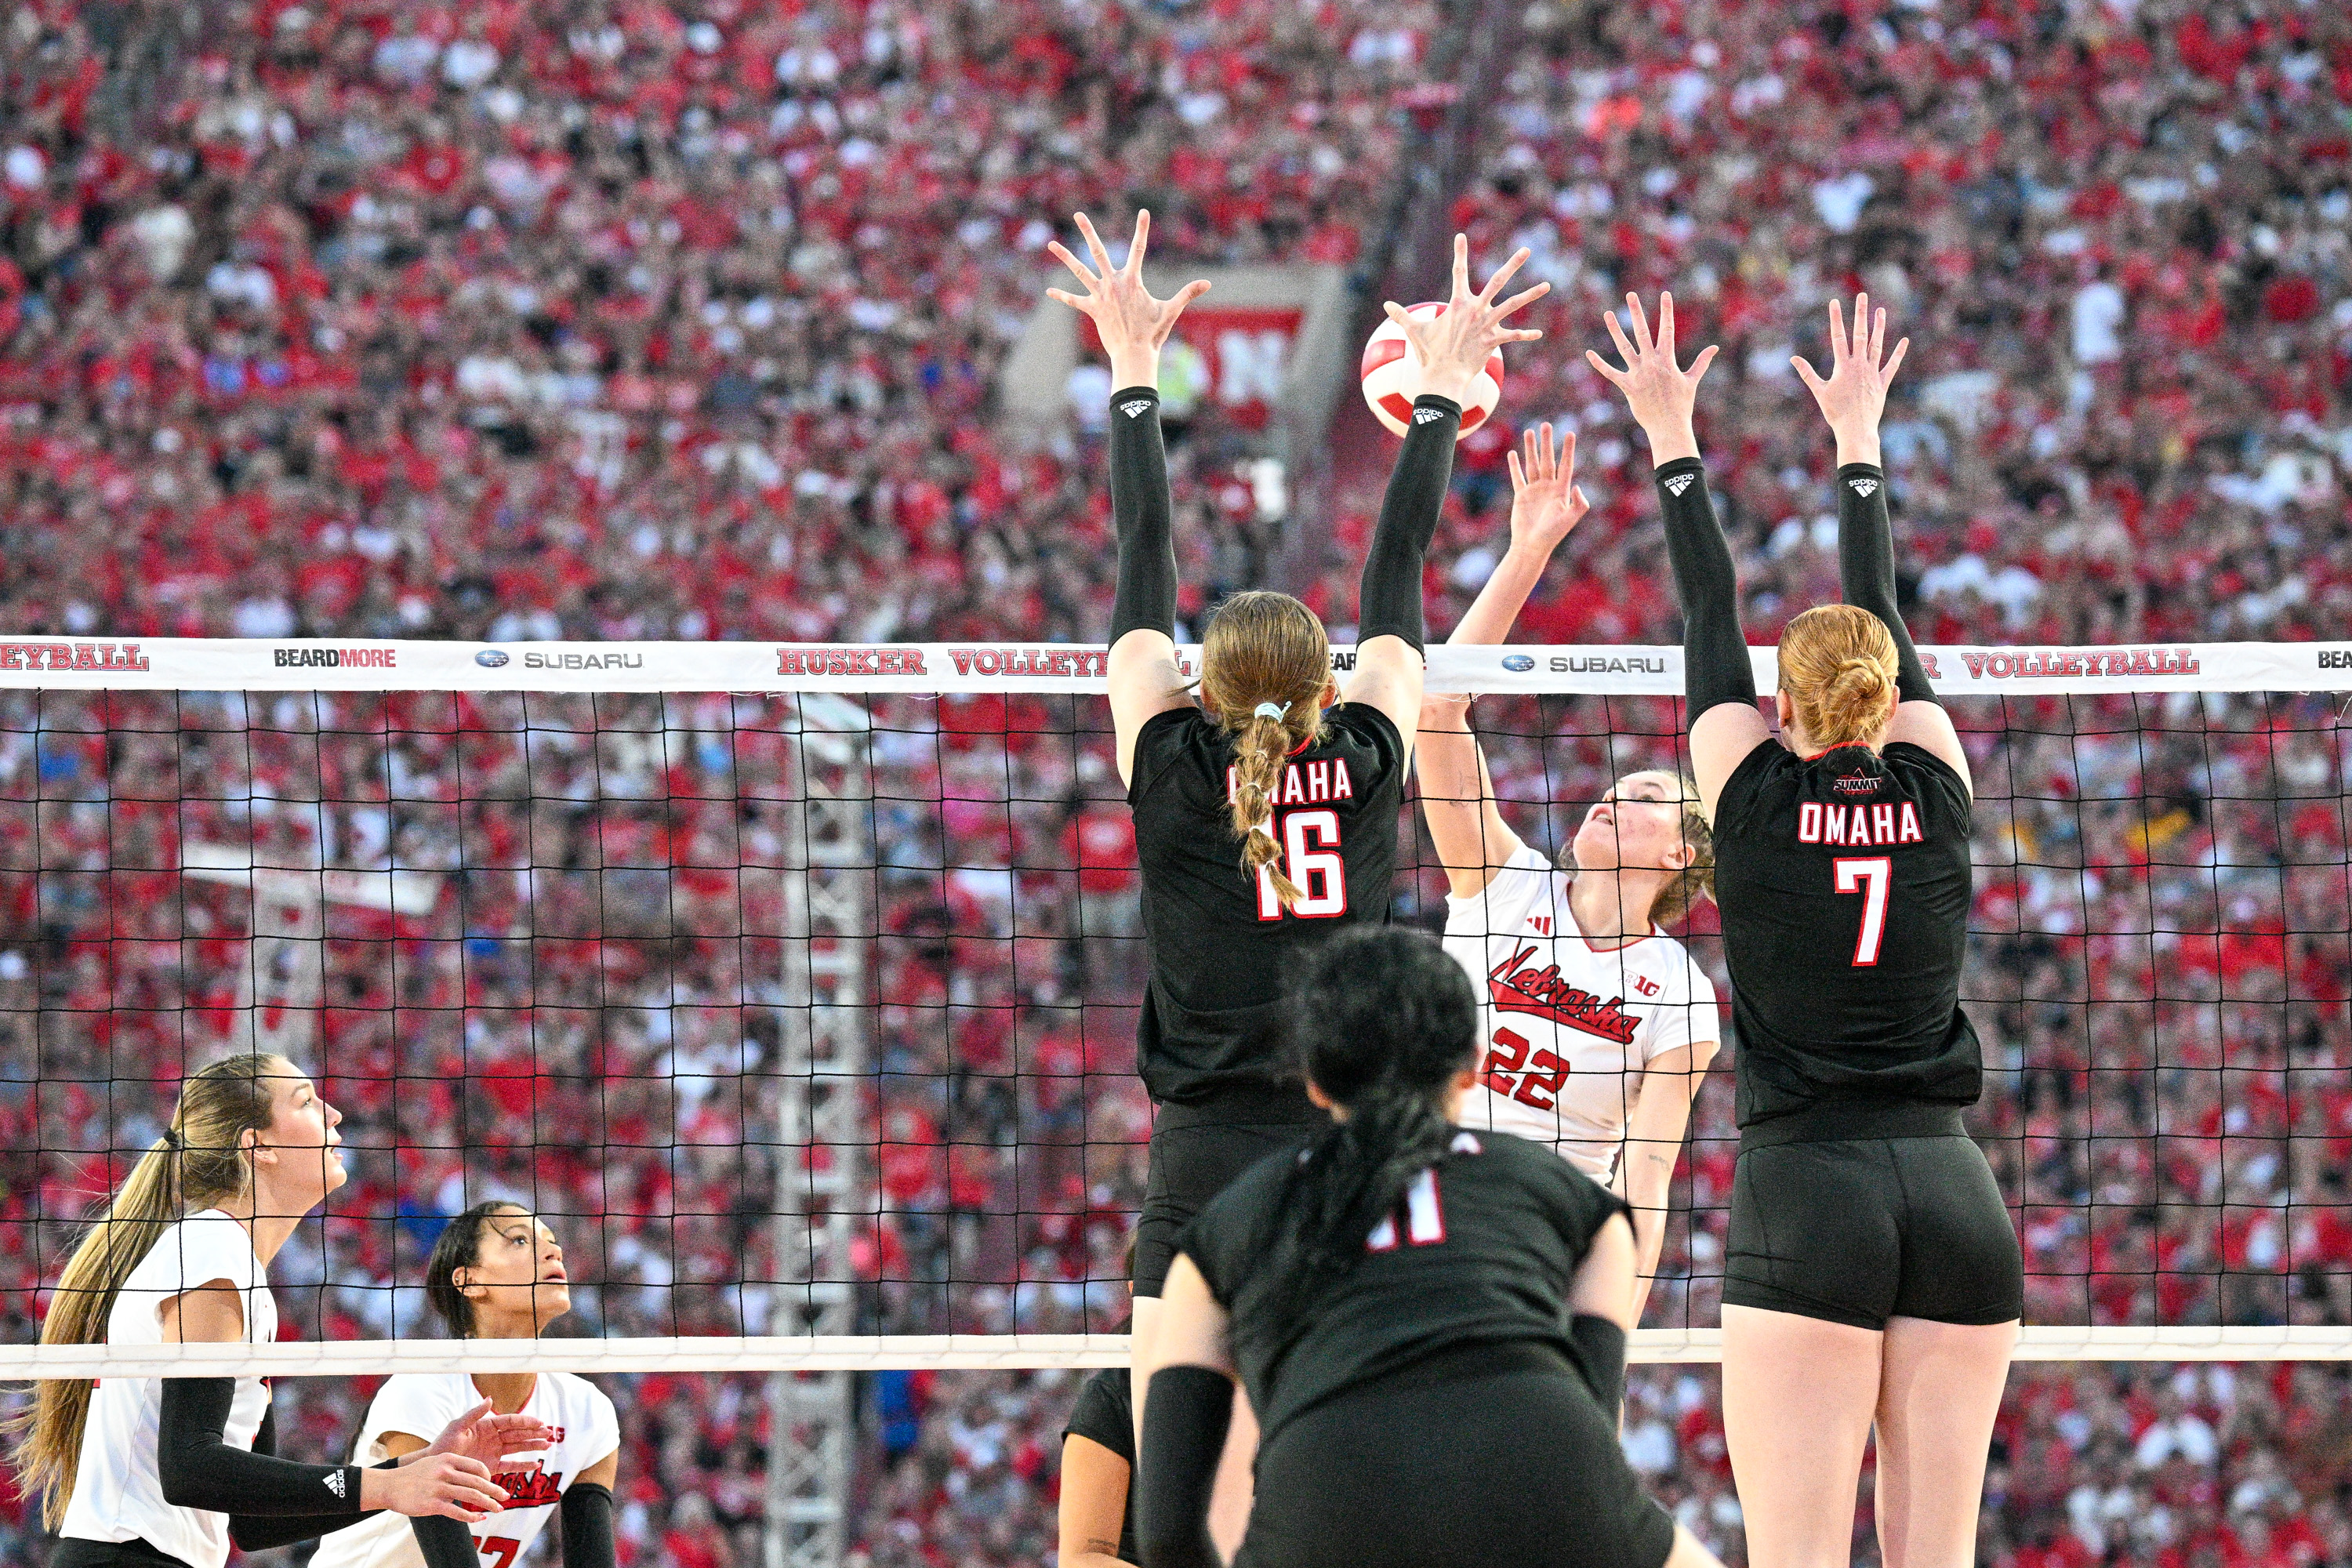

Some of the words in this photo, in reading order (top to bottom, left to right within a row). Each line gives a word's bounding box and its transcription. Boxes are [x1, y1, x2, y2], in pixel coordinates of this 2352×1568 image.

[1120, 400, 1152, 411] adidas
[1413, 408, 1444, 418] adidas
[1664, 474, 1694, 487] adidas
[1849, 478, 1878, 487] adidas
[274, 648, 396, 669] BEARDMORE
[524, 652, 644, 670] SUBARU
[777, 648, 927, 676] HUSKER
[1550, 656, 1665, 673] SUBARU
[1961, 648, 2200, 680] VOLLEYBALL
[1834, 778, 1881, 791] SUMMIT
[1798, 801, 1924, 846] OMAHA
[1249, 808, 1348, 921] 16
[1832, 856, 1892, 967] 7
[1487, 937, 1642, 1039] Nebraska
[1477, 1026, 1570, 1111] 22
[336, 1469, 346, 1498] adidas
